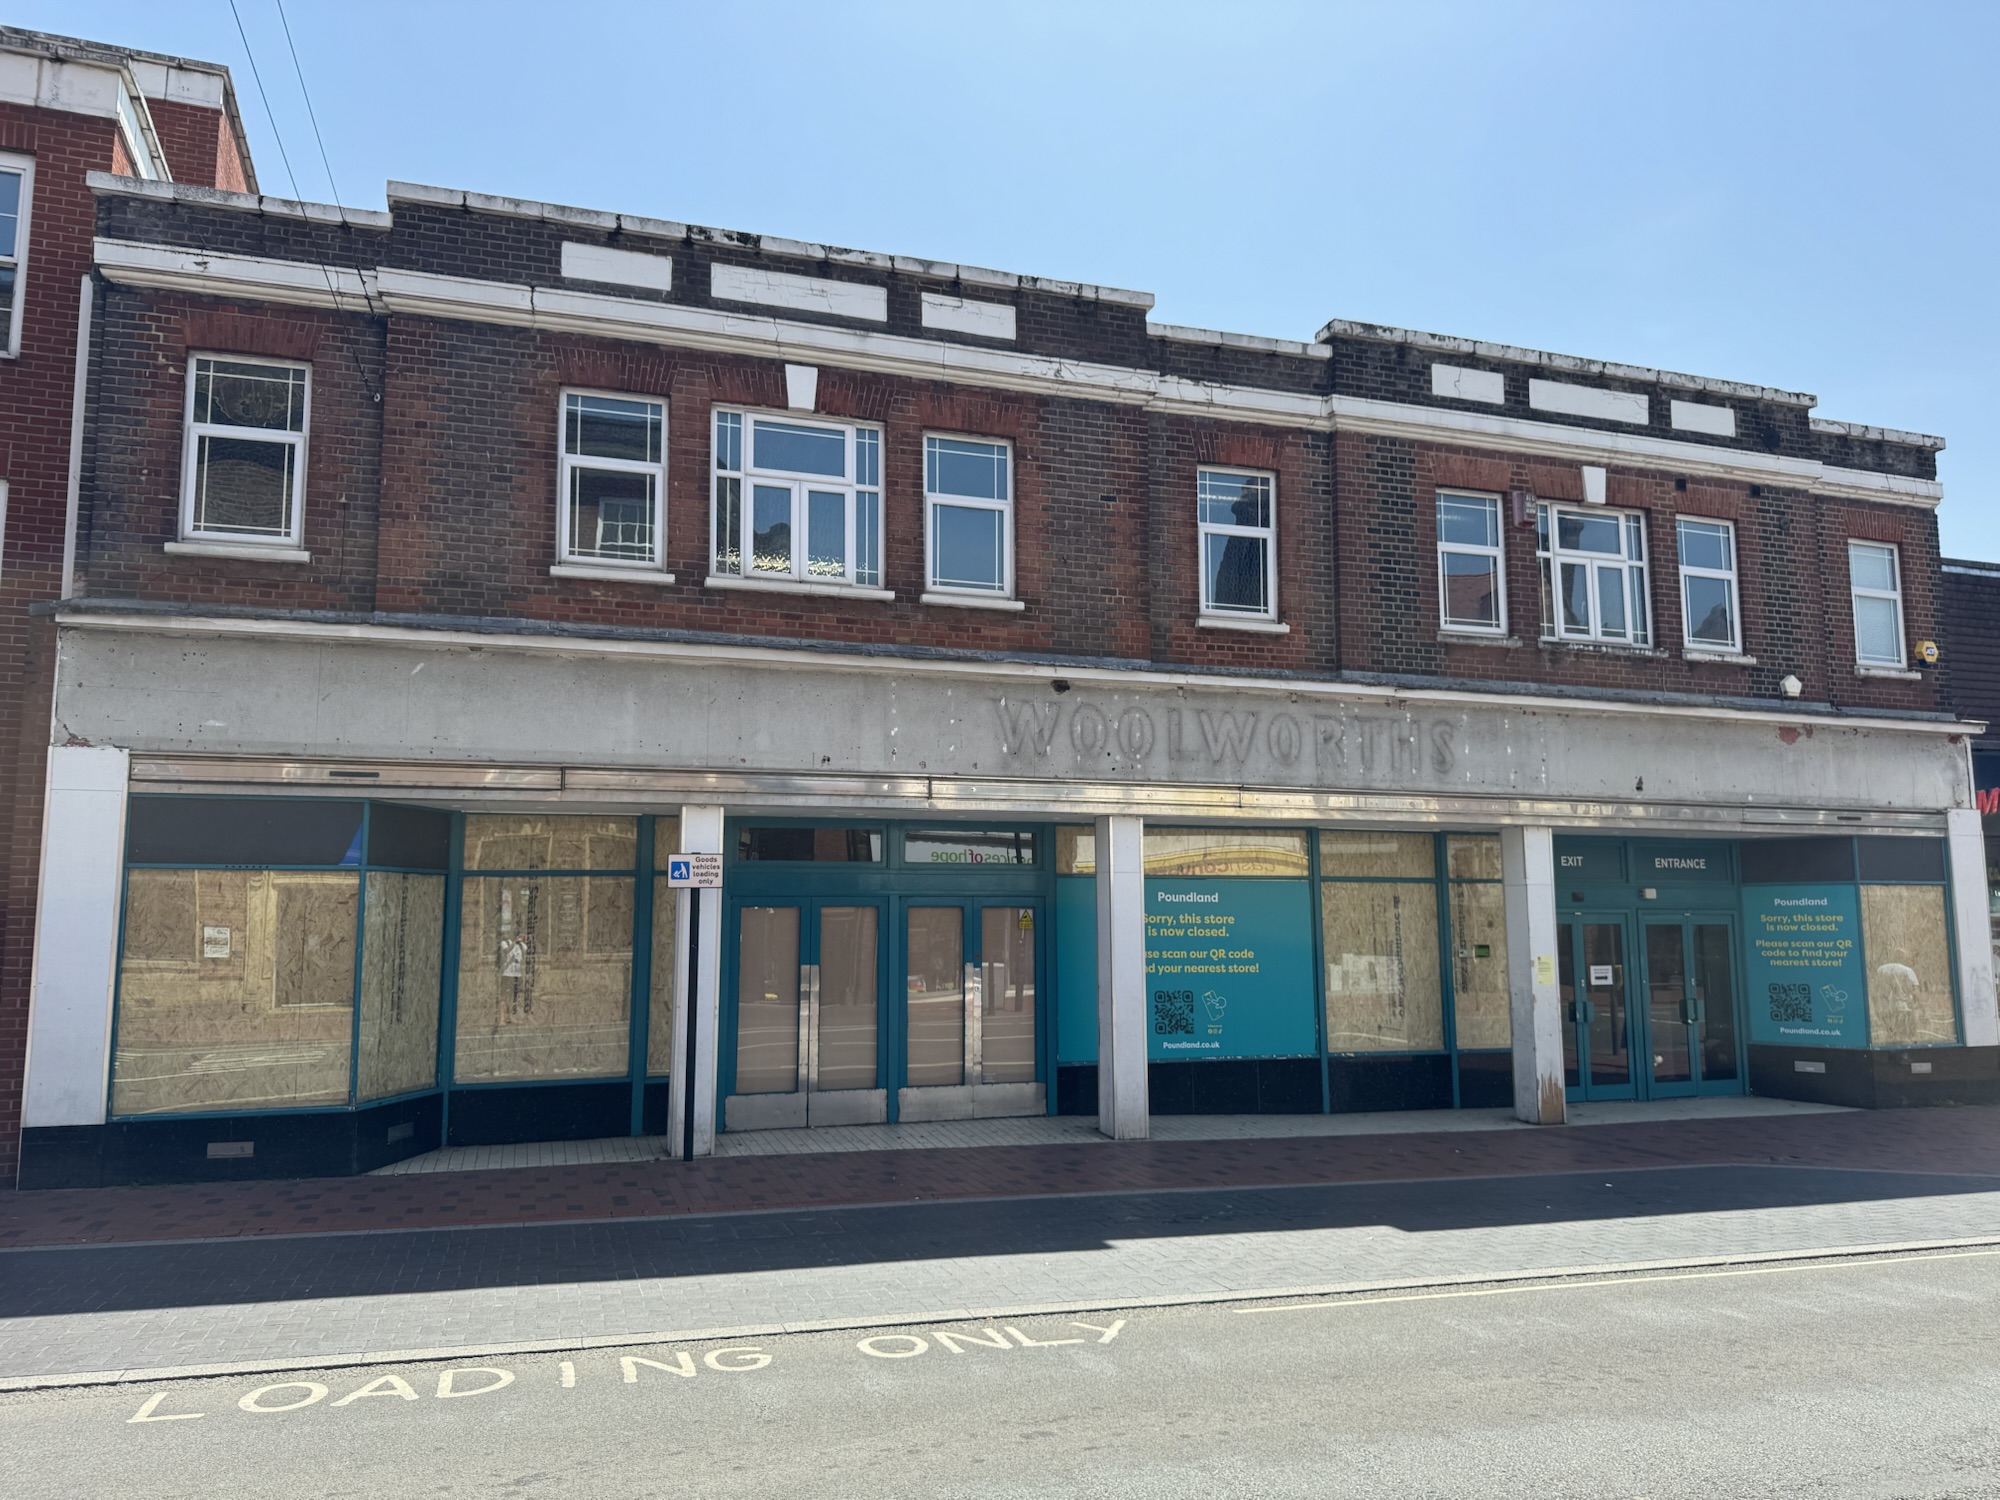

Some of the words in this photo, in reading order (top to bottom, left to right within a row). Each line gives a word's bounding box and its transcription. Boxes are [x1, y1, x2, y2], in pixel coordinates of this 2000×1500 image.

[993, 699, 1455, 774] WOOLWORTHS
[1560, 856, 1584, 867] EXIT
[1654, 857, 1707, 869] ENTRANCE
[1157, 891, 1219, 902] Poundland
[1774, 898, 1828, 906] Poundland
[1179, 913, 1202, 924] this
[1204, 914, 1235, 924] store
[1760, 914, 1791, 924] Sorry,
[1792, 913, 1814, 922] this
[1815, 914, 1844, 922] store
[1147, 926, 1158, 936] is
[1160, 928, 1185, 936] now
[1187, 926, 1230, 937] closed.
[1766, 923, 1775, 931] is
[1800, 923, 1839, 931] closed.
[1755, 939, 1789, 948] Please
[1836, 940, 1853, 949] QR
[1162, 950, 1187, 958] scan
[1189, 950, 1208, 958] our
[1210, 949, 1226, 960] QR
[1228, 949, 1254, 958] code
[1761, 949, 1786, 957] code
[1788, 949, 1799, 957] to
[1801, 949, 1822, 957] find
[1824, 950, 1848, 959] your
[1770, 959, 1810, 967] nearest
[1811, 959, 1842, 967] store!
[1158, 964, 1182, 975] your
[1184, 964, 1226, 973] nearest
[1228, 963, 1260, 973] store!
[1780, 1026, 1842, 1036] Poundland.co.uk
[1162, 1041, 1220, 1049] Poundland.co.uk
[126, 1346, 773, 1424] LOADING
[856, 1319, 1127, 1358] ONLY
